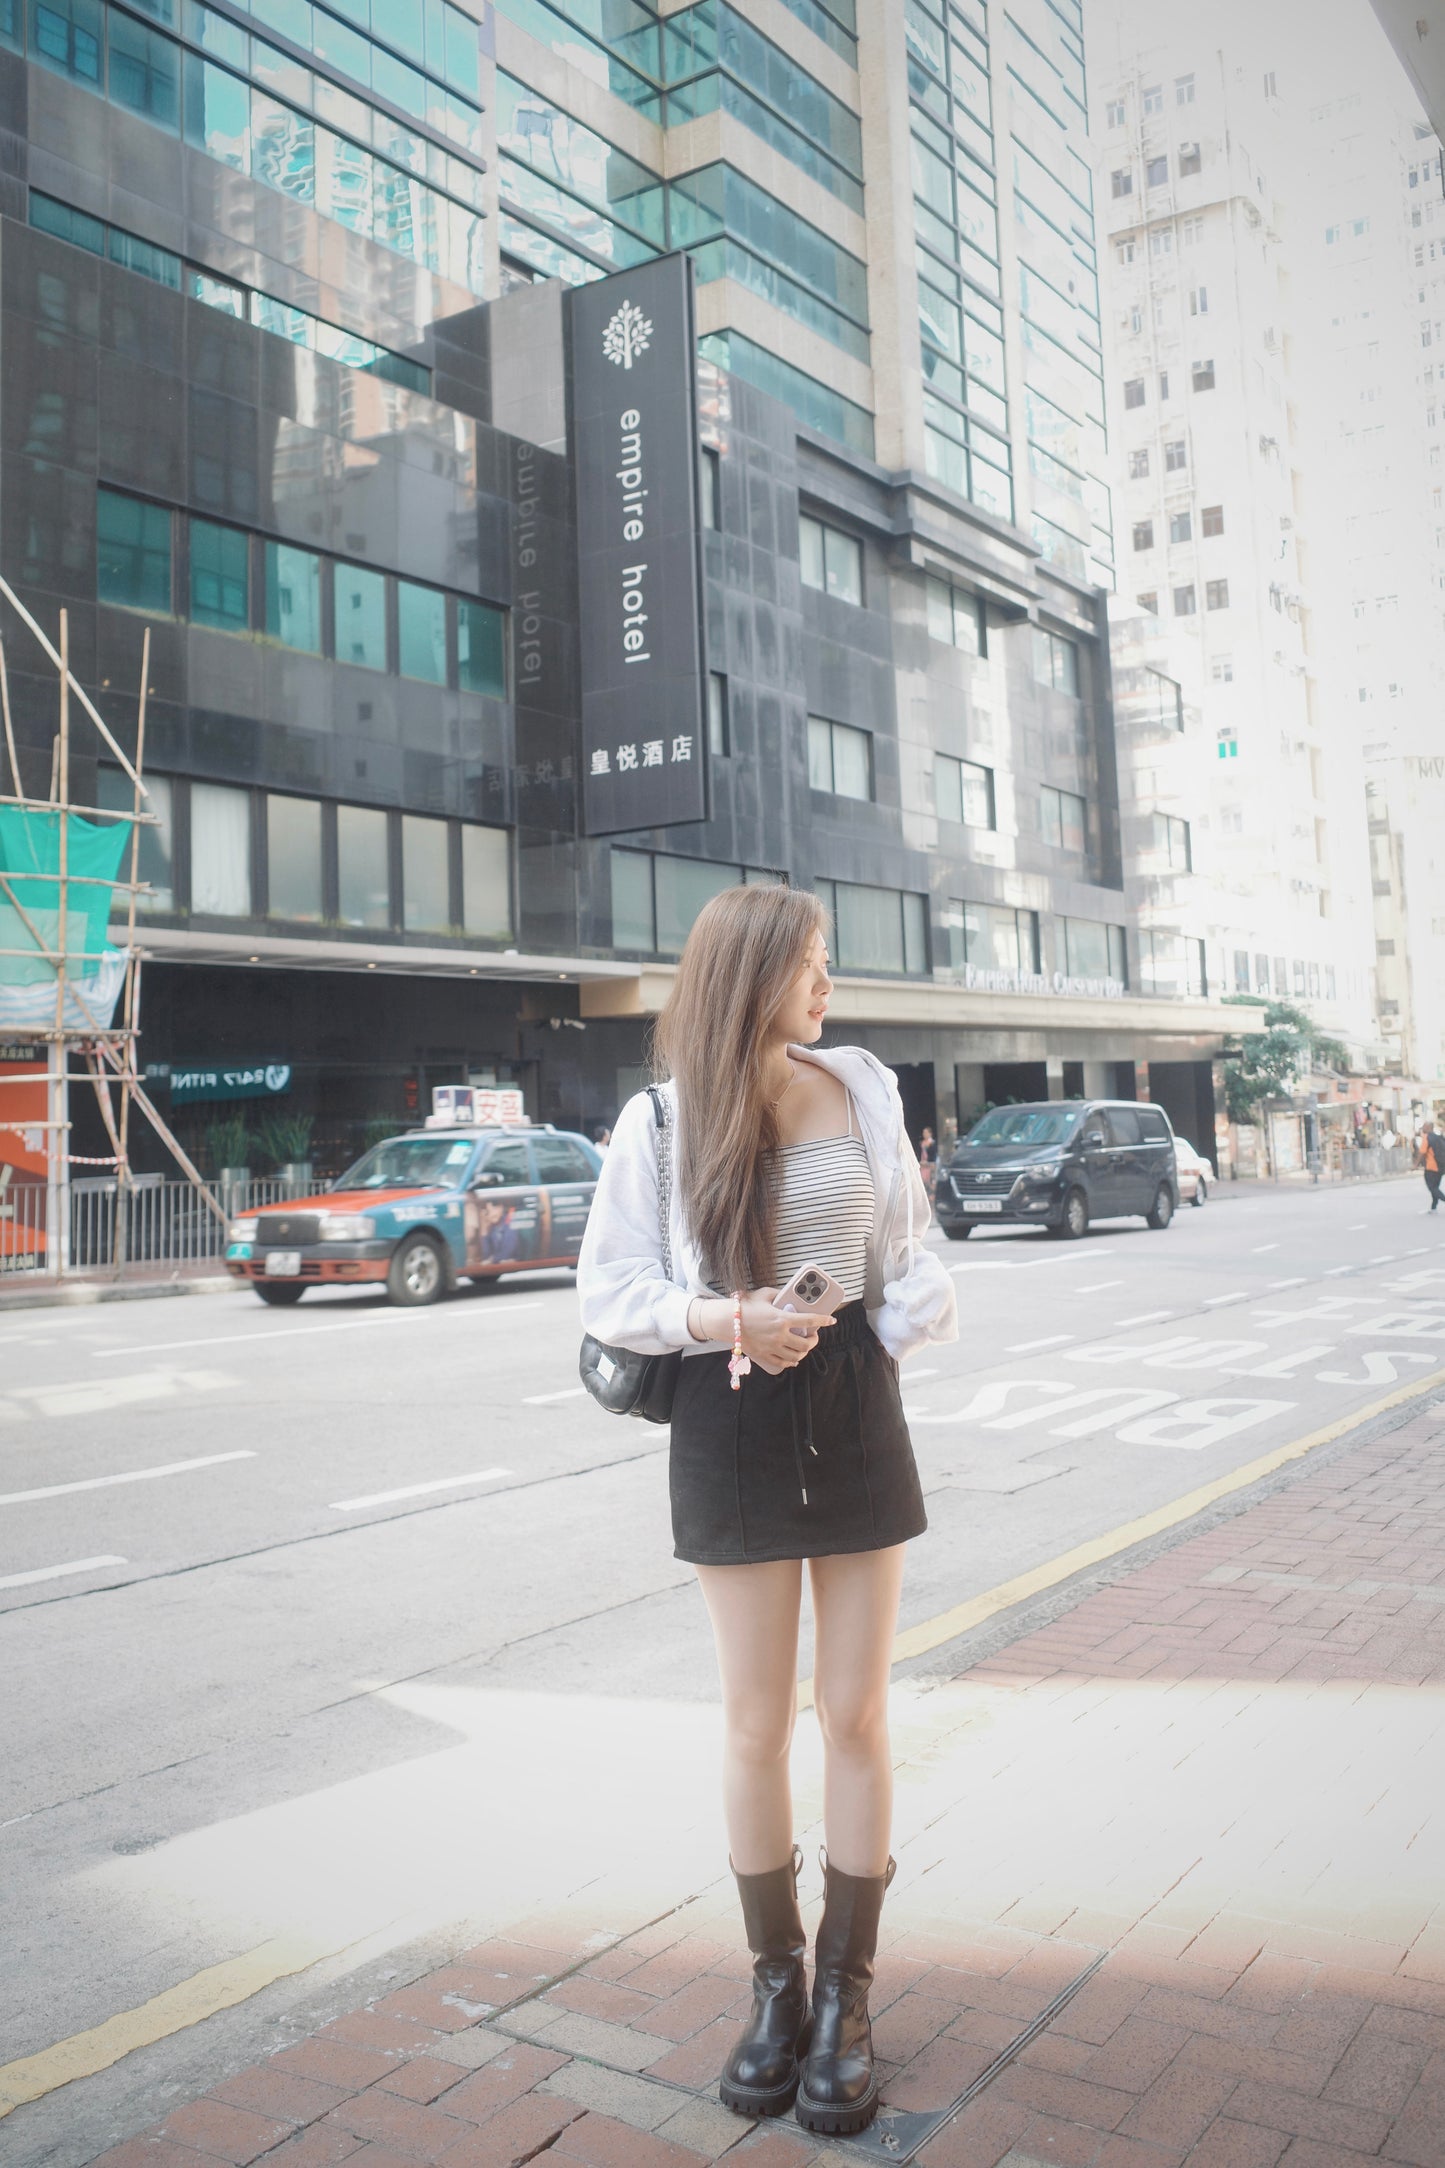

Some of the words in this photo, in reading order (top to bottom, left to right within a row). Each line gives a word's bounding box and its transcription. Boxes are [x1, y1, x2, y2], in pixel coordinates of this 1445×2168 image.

[615, 408, 649, 541] empire
[622, 563, 651, 664] hotel
[1062, 1335, 1438, 1386] STOP
[904, 1380, 1298, 1450] BUS
